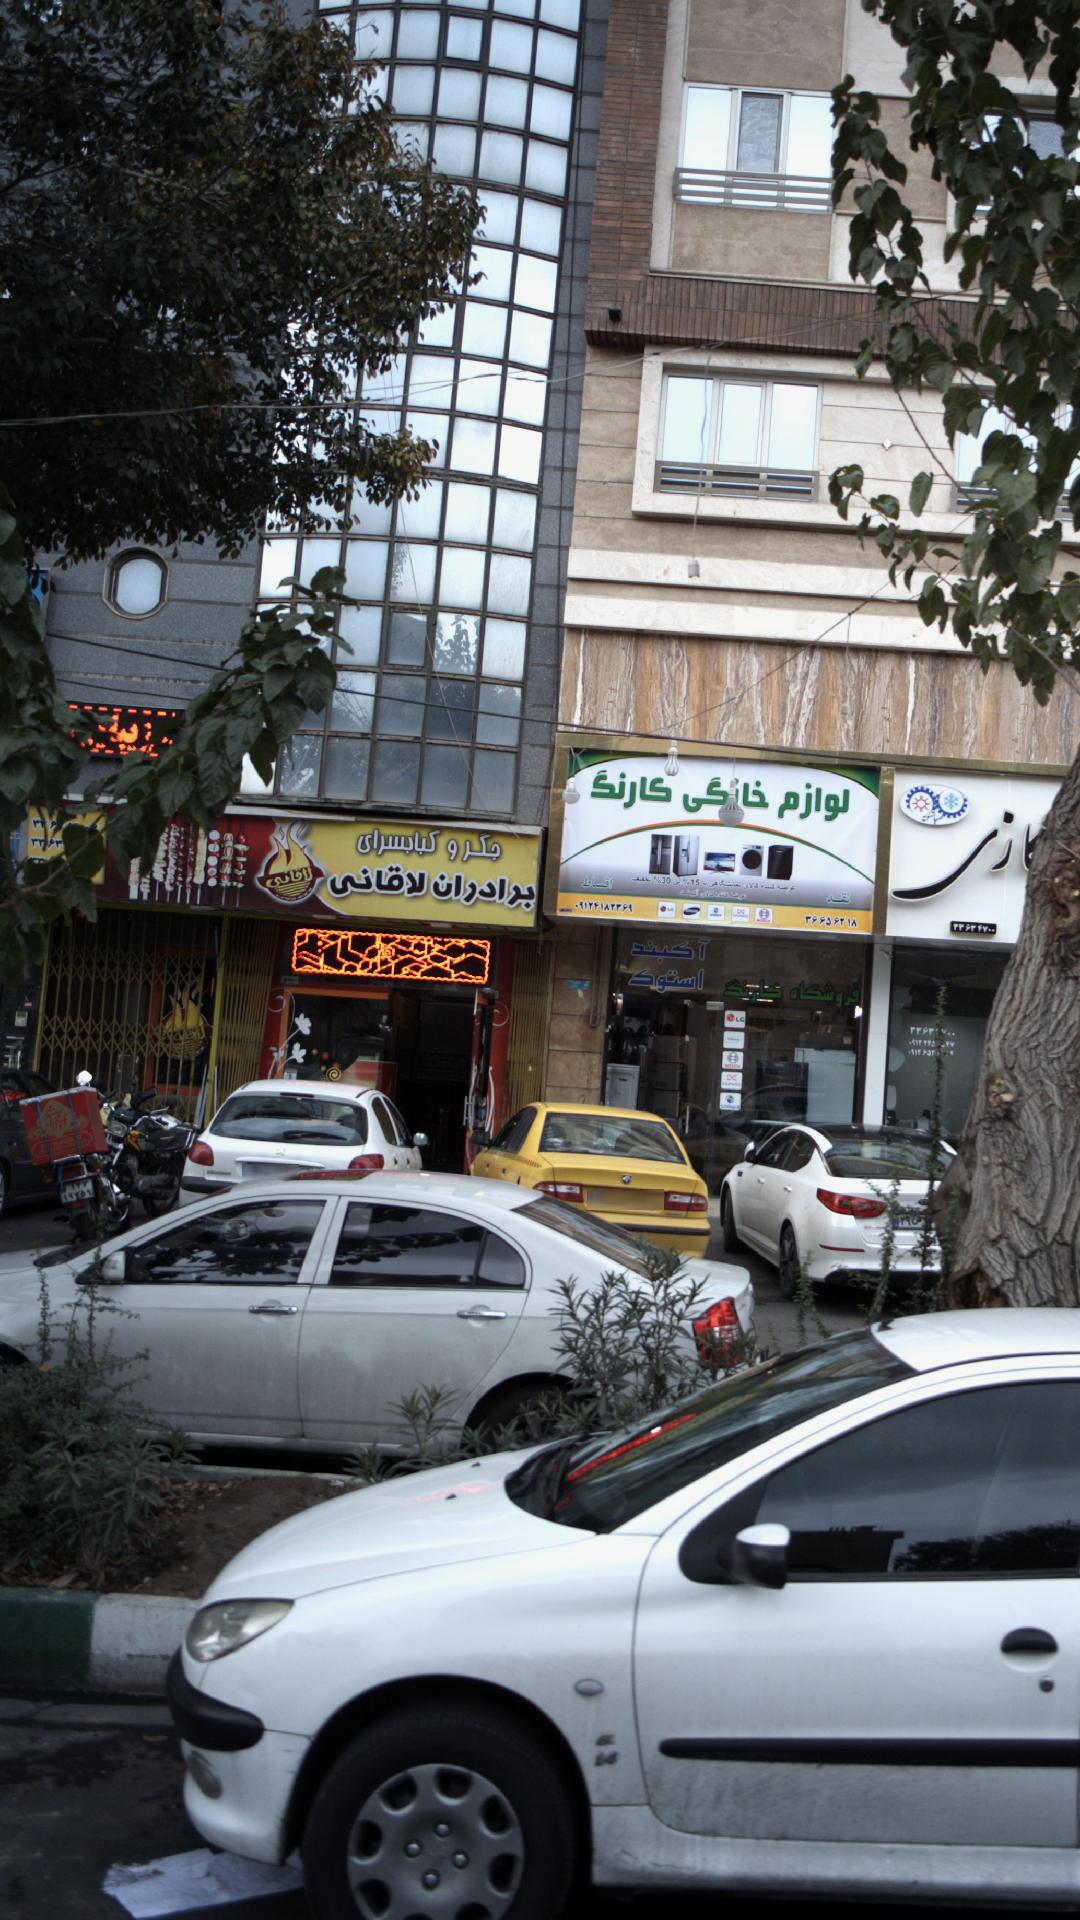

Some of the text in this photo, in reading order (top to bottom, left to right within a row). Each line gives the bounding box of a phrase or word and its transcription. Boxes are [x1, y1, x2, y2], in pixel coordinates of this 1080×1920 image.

[590, 770, 672, 809] کارنگ
[777, 782, 850, 822] لوازم
[447, 842, 459, 861] و
[461, 832, 502, 862] جگر
[329, 863, 536, 909] برادران لاقانی
